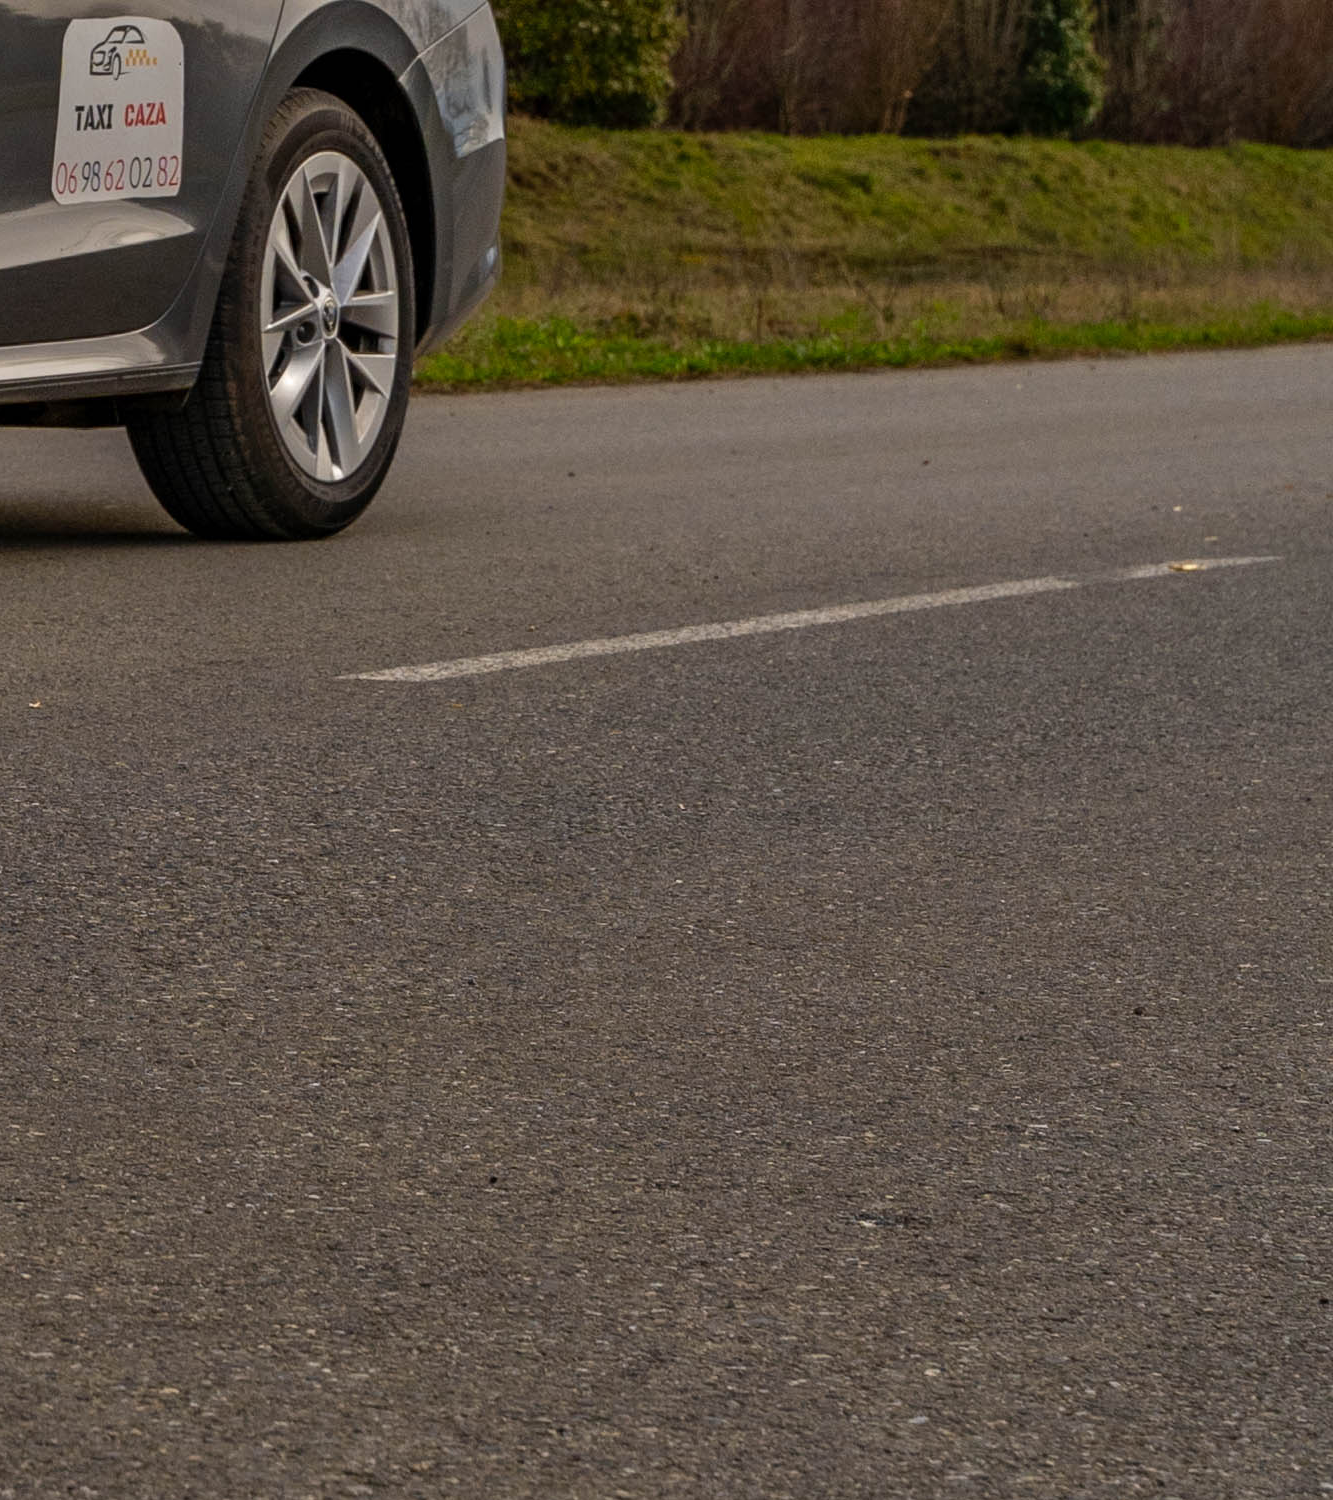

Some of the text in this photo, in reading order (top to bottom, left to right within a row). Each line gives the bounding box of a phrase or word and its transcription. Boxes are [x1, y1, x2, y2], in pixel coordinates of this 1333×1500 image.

[74, 102, 167, 131] TAXI CAZA
[55, 155, 179, 195] 06 98 62 02 82
